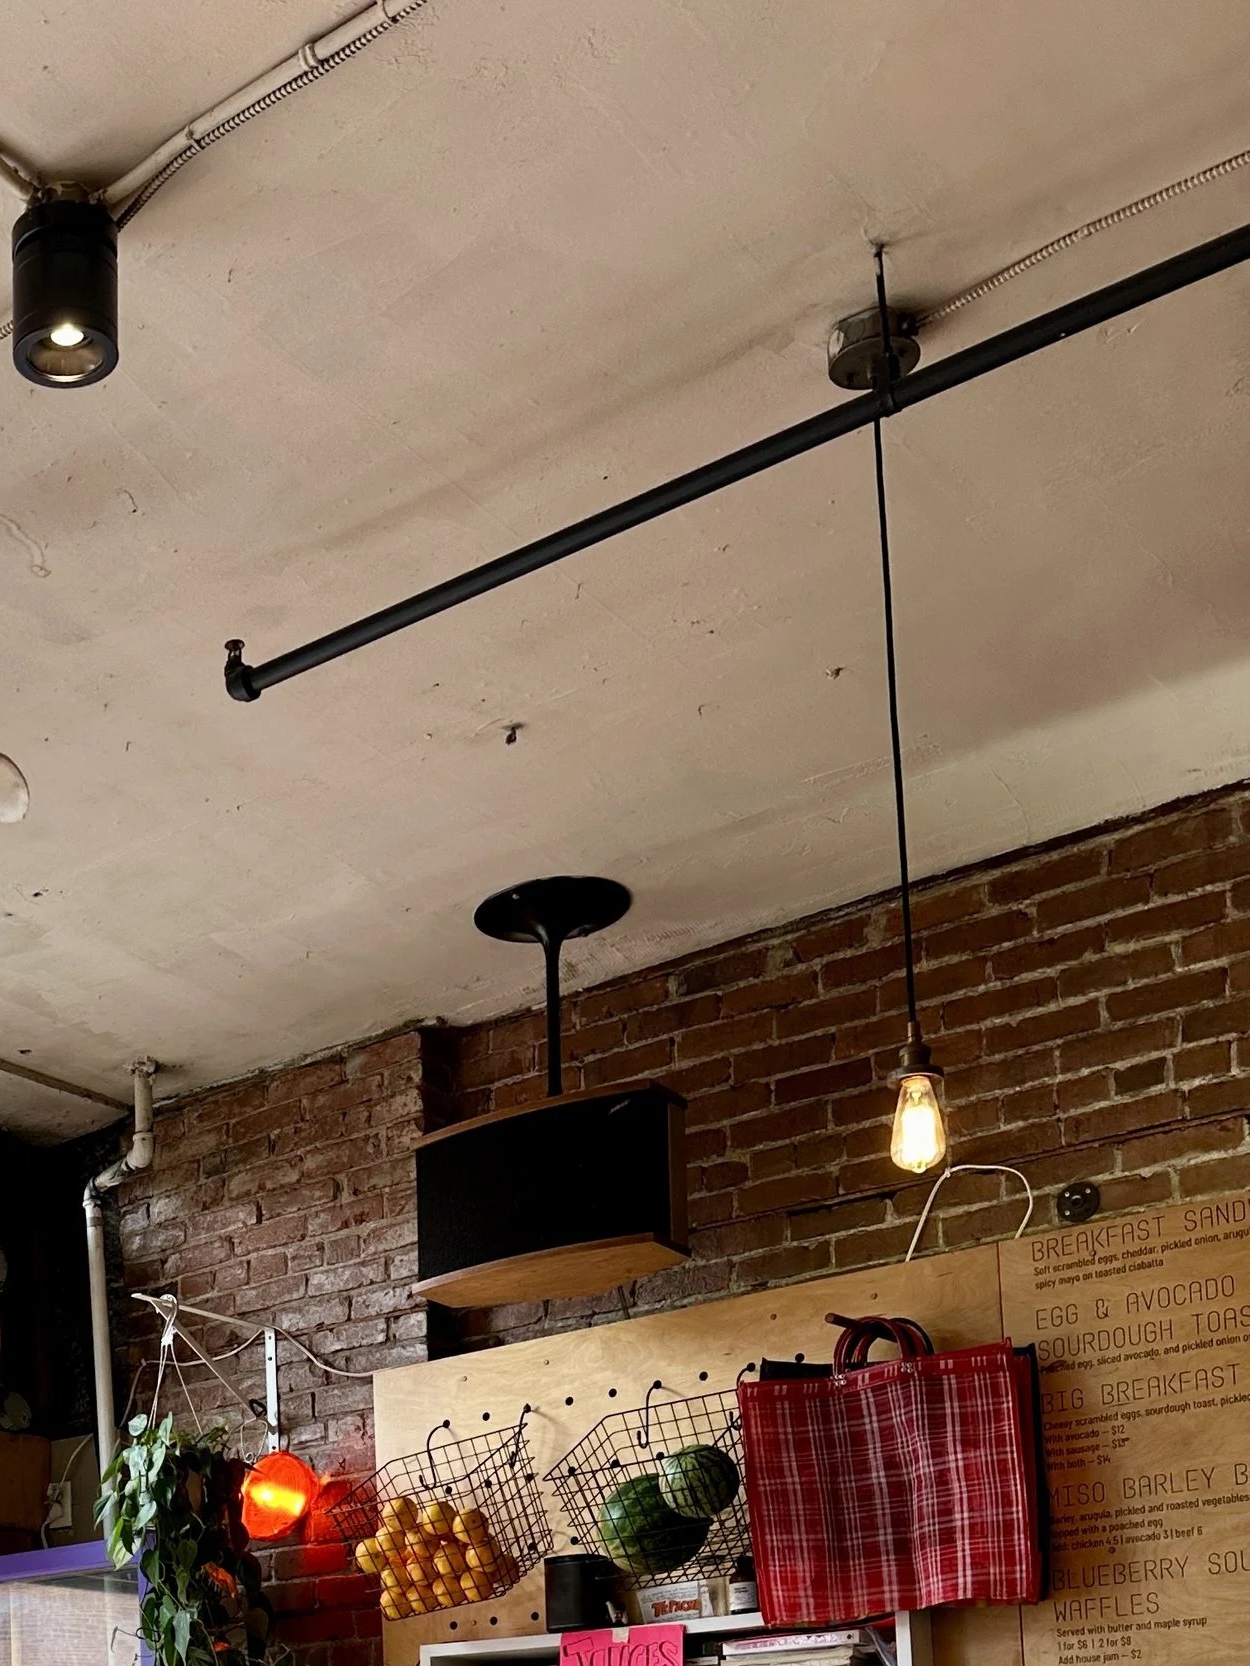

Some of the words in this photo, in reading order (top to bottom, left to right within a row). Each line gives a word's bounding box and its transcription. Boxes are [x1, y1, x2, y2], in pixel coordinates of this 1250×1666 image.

[1031, 1216, 1165, 1262] BREAKFAST
[1184, 1198, 1250, 1232] SAND
[1034, 1264, 1050, 1276] Soft
[1053, 1256, 1095, 1272] scrambled
[1098, 1253, 1119, 1266] eggs,
[1161, 1238, 1192, 1255] pickled
[1223, 1228, 1250, 1242] arugu
[1035, 1277, 1056, 1290] spicy
[1058, 1274, 1080, 1286] mayo
[1082, 1272, 1093, 1280] on
[1094, 1264, 1126, 1278] toasted
[1129, 1259, 1164, 1272] ciabatta
[1036, 1304, 1078, 1330] EGG
[1095, 1298, 1109, 1320] &
[1126, 1275, 1235, 1314] AVOCADO
[1038, 1319, 1173, 1361] SOURDOUGH
[1191, 1305, 1250, 1335] TOAS
[1097, 1354, 1122, 1366] sliced
[1164, 1344, 1180, 1355] and
[1182, 1338, 1214, 1354] pickled
[1216, 1335, 1241, 1346] onion
[1041, 1387, 1084, 1415] BIG
[1101, 1363, 1240, 1406] BREAKFAST
[1075, 1413, 1118, 1427] scrambled
[1145, 1401, 1191, 1416] sourdough
[1065, 1428, 1099, 1441] avocado
[1111, 1424, 1125, 1436] $12
[1066, 1443, 1100, 1456] sausage
[1067, 1457, 1085, 1469] both
[1097, 1455, 1111, 1465] $14
[1050, 1482, 1105, 1508] MISO
[1123, 1466, 1215, 1500] BARLEY
[1115, 1505, 1145, 1519] pickled
[1148, 1503, 1163, 1513] and
[1166, 1499, 1199, 1510] roasted
[1072, 1536, 1104, 1548] chicken
[1106, 1534, 1120, 1546] 4.5
[1125, 1532, 1161, 1544] avocado
[1163, 1530, 1169, 1539] 3
[1175, 1527, 1194, 1538] beef
[1197, 1525, 1203, 1535] 6
[1081, 1524, 1099, 1533] with
[1109, 1519, 1145, 1532] poached
[1147, 1519, 1163, 1528] egg
[1052, 1555, 1189, 1592] BLUEBERRY
[1208, 1550, 1250, 1575] SOU
[1054, 1592, 1159, 1623] WAFFLES
[1057, 1626, 1085, 1637] Served
[1087, 1624, 1105, 1635] with
[1108, 1622, 1133, 1633] butter
[1136, 1620, 1151, 1630] and
[1154, 1618, 1180, 1630] maple
[1182, 1616, 1207, 1627] syrup
[1057, 1641, 1061, 1651] 1
[1063, 1640, 1074, 1650] for
[1077, 1639, 1087, 1650] $6
[1099, 1638, 1104, 1648] 2
[1106, 1637, 1118, 1647] for
[1121, 1636, 1132, 1646] $8
[1058, 1655, 1074, 1665] Add
[1076, 1653, 1101, 1664] house
[1103, 1652, 1119, 1663] jam
[1131, 1649, 1142, 1660] $2
